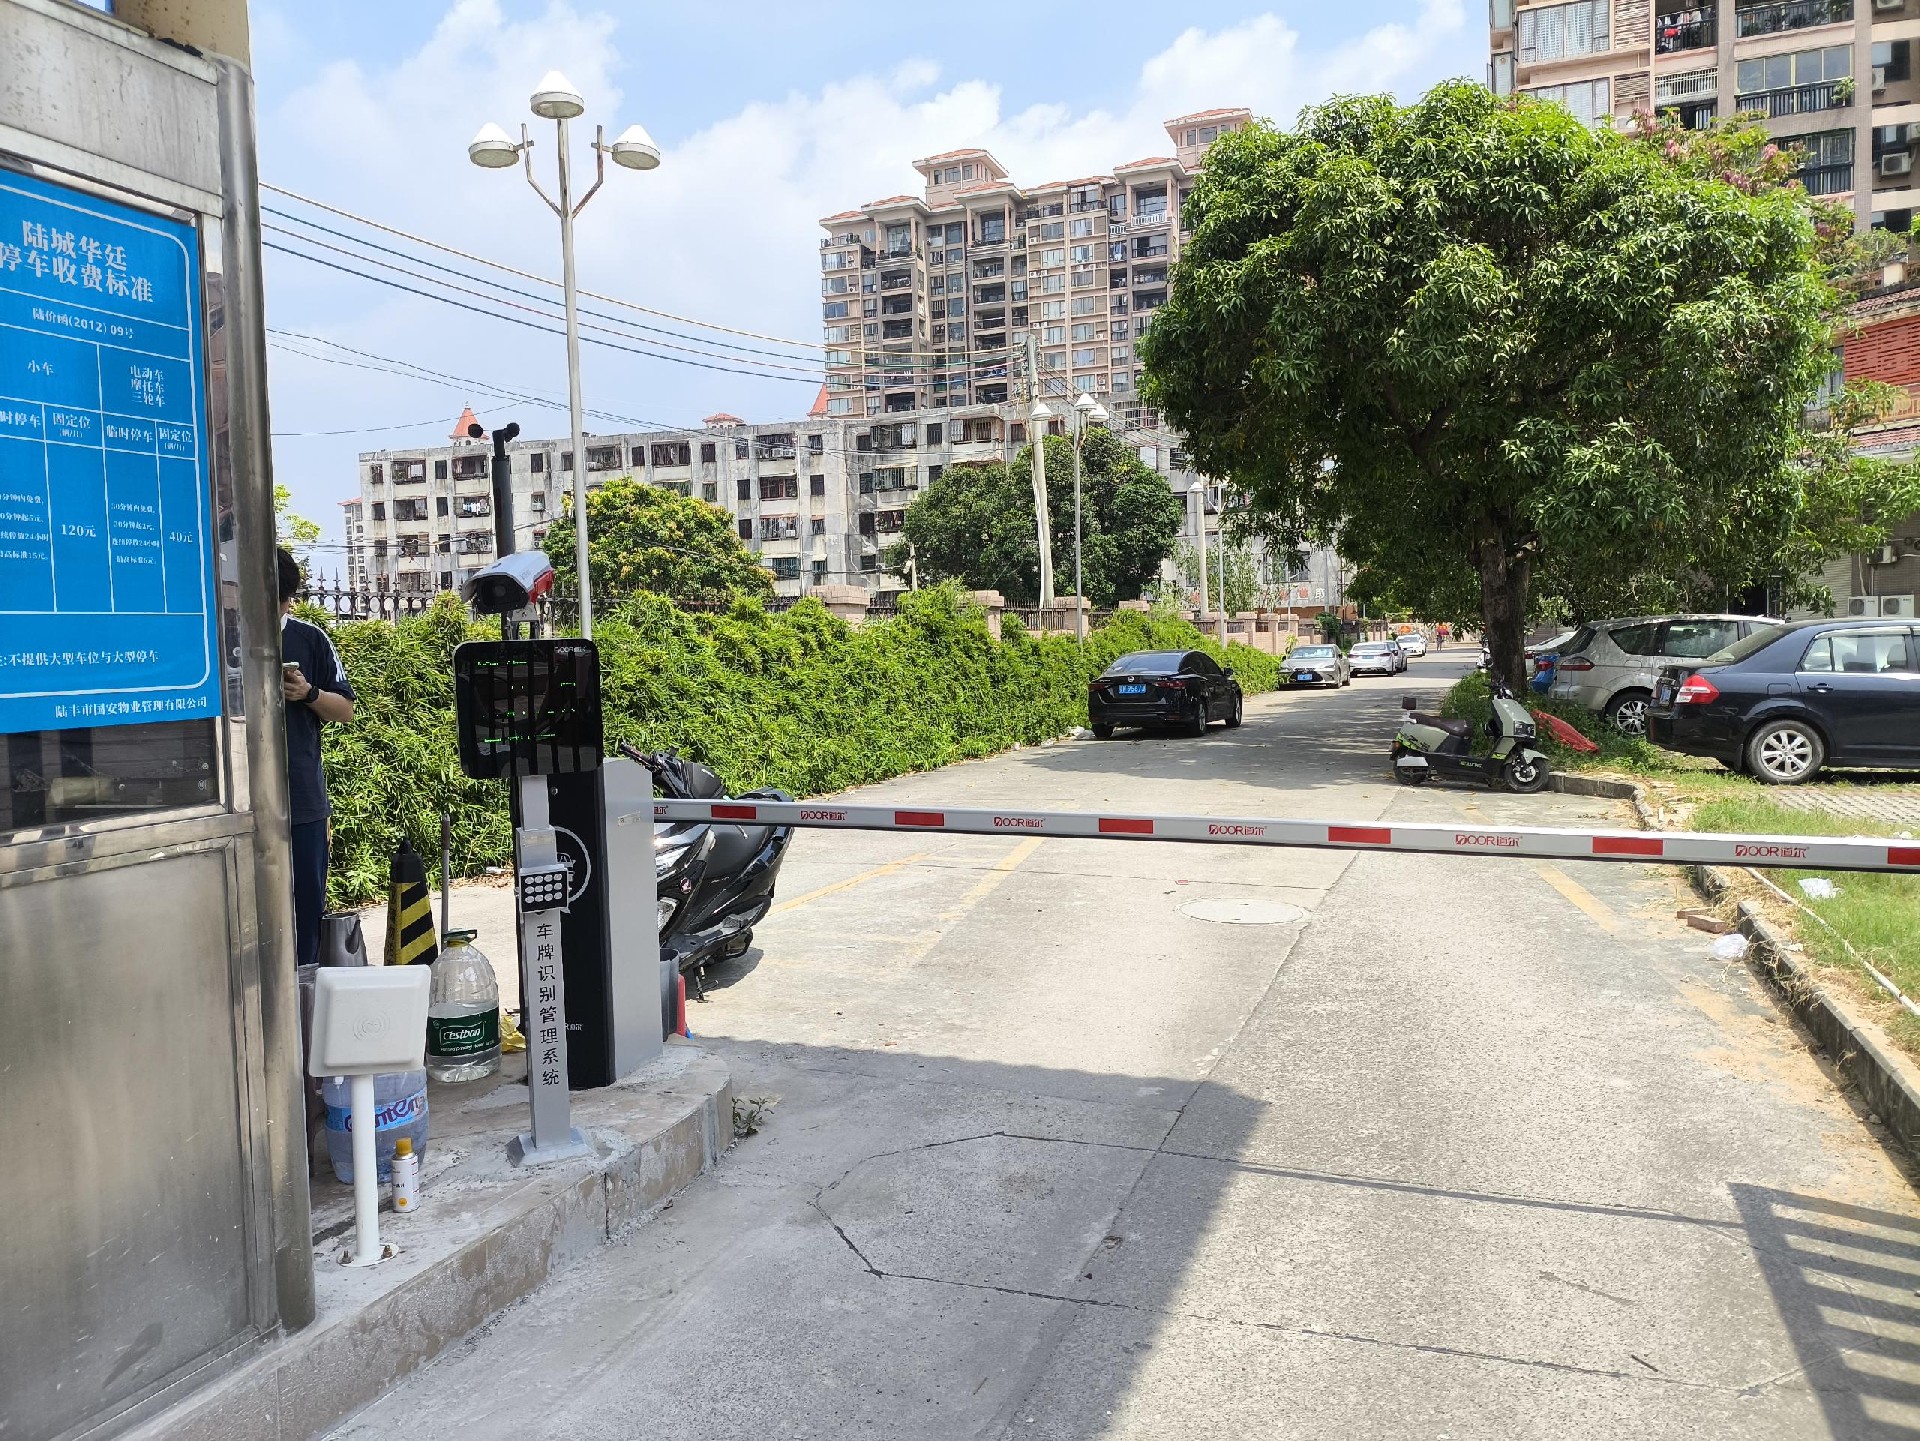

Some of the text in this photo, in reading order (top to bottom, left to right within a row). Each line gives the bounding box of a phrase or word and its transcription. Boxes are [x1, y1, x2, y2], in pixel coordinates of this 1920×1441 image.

[22, 220, 128, 272] 陆城华廷
[0, 242, 153, 303] 停车收费标准
[27, 360, 54, 376] 小车
[130, 364, 164, 382] 电动车
[53, 412, 91, 429] 固定位
[106, 424, 153, 443] 临时停车
[158, 427, 193, 443] 固定位
[61, 523, 97, 538] 120元
[169, 531, 193, 543] 40元
[55, 696, 208, 718] 陆丰市国安物业管理有限公司
[536, 923, 560, 1086] 车牌识别管理系统
